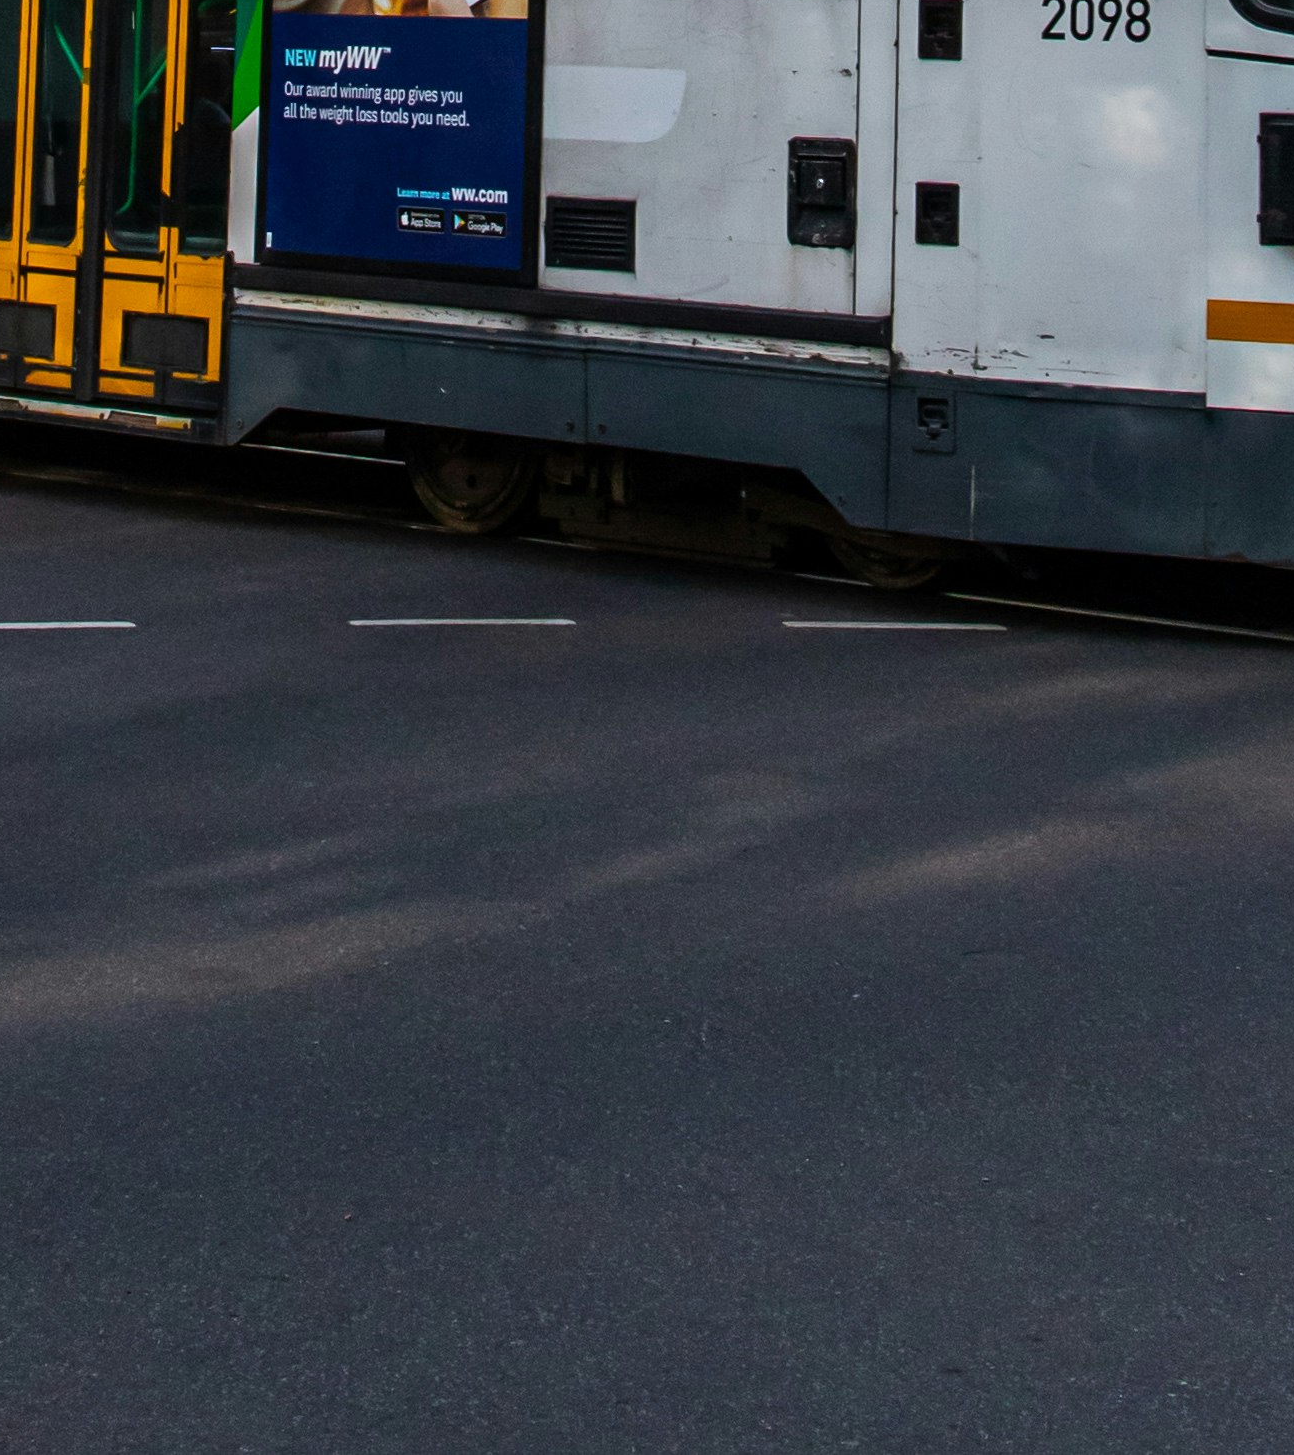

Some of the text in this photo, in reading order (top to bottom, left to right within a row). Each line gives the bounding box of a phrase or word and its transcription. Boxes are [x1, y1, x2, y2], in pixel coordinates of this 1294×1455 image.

[285, 49, 316, 67] NEW
[284, 81, 463, 107] Our award winning app gives you
[283, 103, 471, 129] all the weight loss tools you need.
[397, 187, 419, 198] Learn
[420, 190, 440, 200] more
[441, 191, 450, 200] at
[410, 217, 423, 227] App
[467, 221, 504, 234] Google Play
